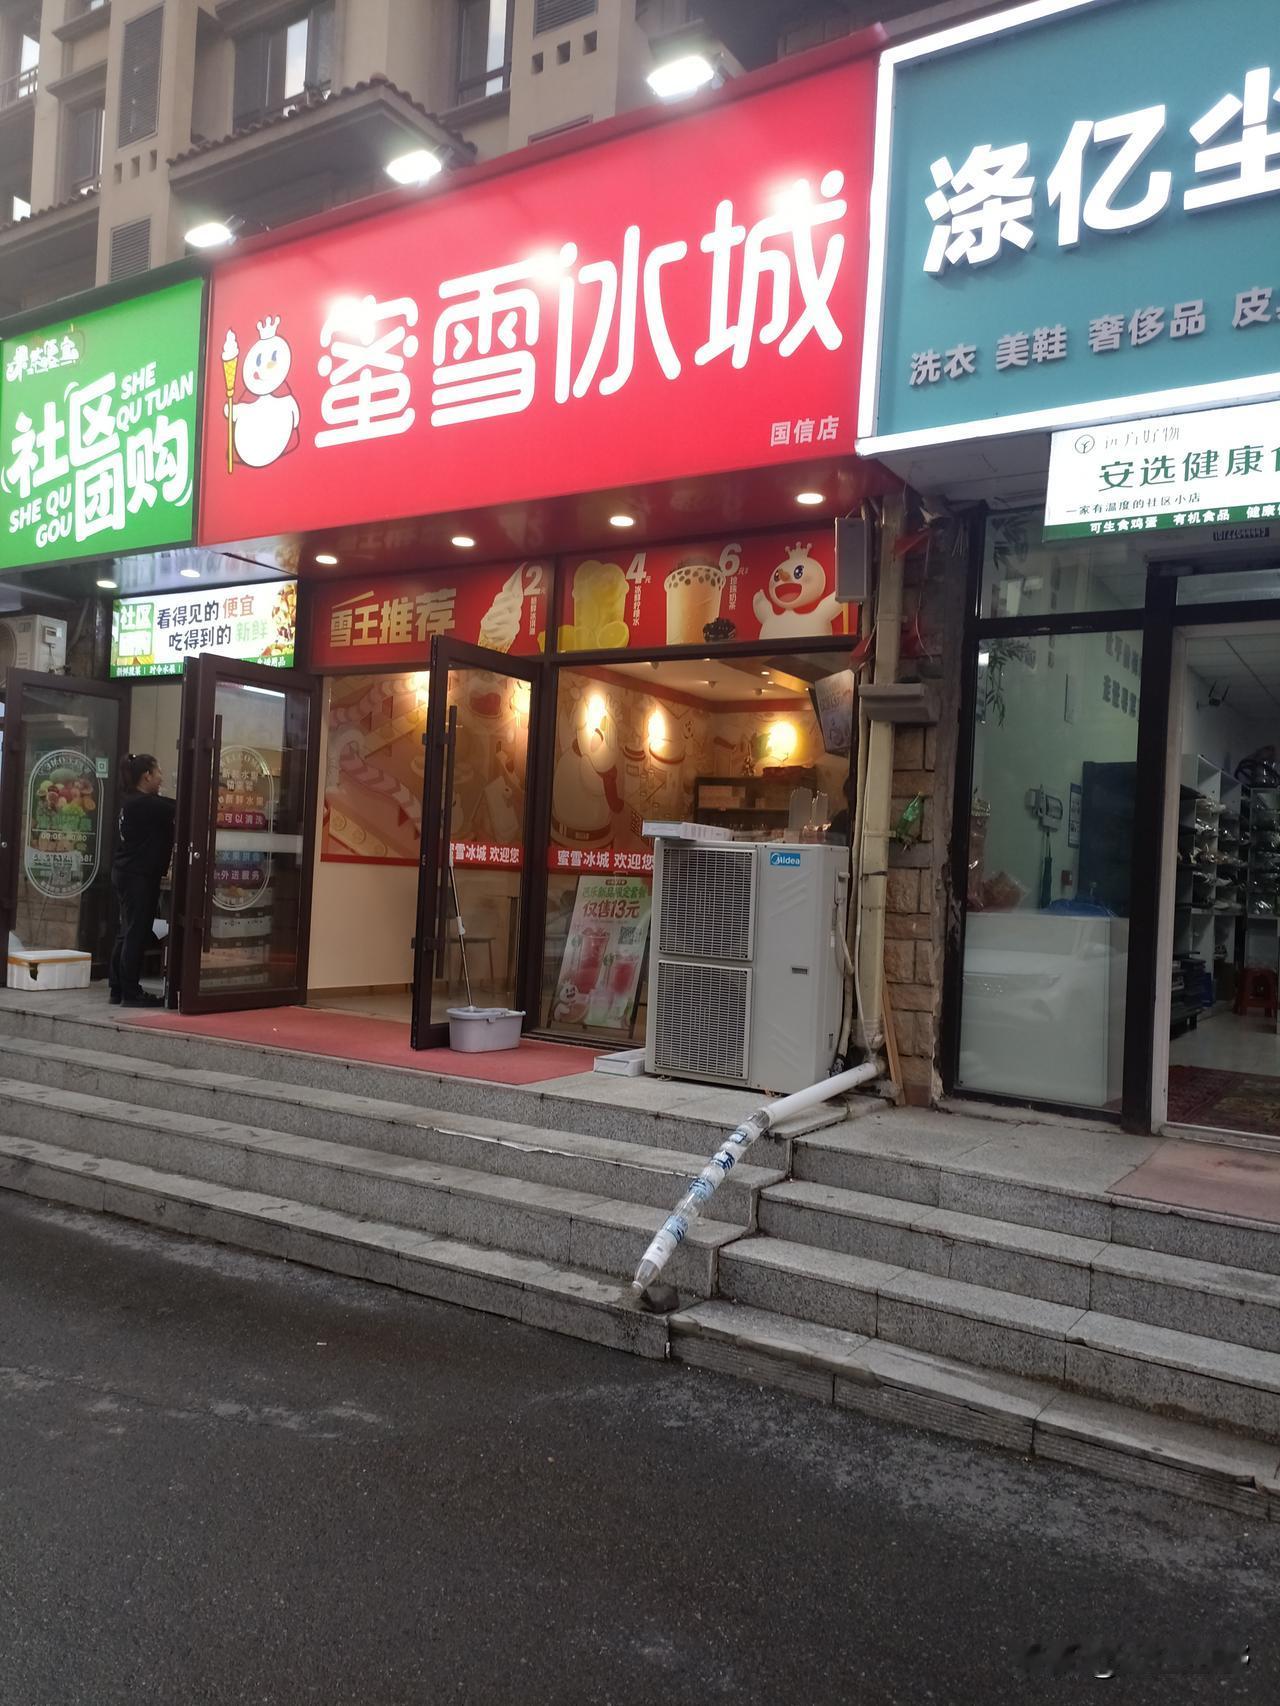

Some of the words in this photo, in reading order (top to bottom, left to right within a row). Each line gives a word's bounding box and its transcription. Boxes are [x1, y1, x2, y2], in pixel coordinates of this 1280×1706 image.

[314, 169, 848, 449] 蜜雪冰城
[909, 344, 978, 387] 洗衣
[995, 324, 1068, 371] 美鞋
[1088, 299, 1206, 354] 奢侈品
[1231, 286, 1280, 329] 皮
[121, 362, 157, 400] SHE
[116, 400, 142, 432] QU
[147, 371, 194, 416] TUAN
[7, 372, 120, 498] 社区
[770, 416, 840, 447] 国信店
[75, 415, 190, 542] 团购
[1098, 445, 1280, 492] 安选健康
[9, 498, 42, 533] SHE
[46, 483, 72, 516] QU
[1066, 493, 1200, 516] 一家有温度的社区小店
[1090, 516, 1158, 534] 可生食鸡蛋
[1173, 508, 1230, 526] 有机食品
[1246, 503, 1280, 519] 健康
[35, 512, 72, 548] GOU
[157, 595, 255, 630] 看得见的便宜
[330, 587, 457, 647] 雪王推荐
[489, 845, 520, 863] 欢迎您
[557, 850, 610, 868] 蜜雪冰城
[613, 852, 654, 871] 欢迎您
[771, 853, 800, 865] Midea
[583, 900, 641, 919] 仅售13元
